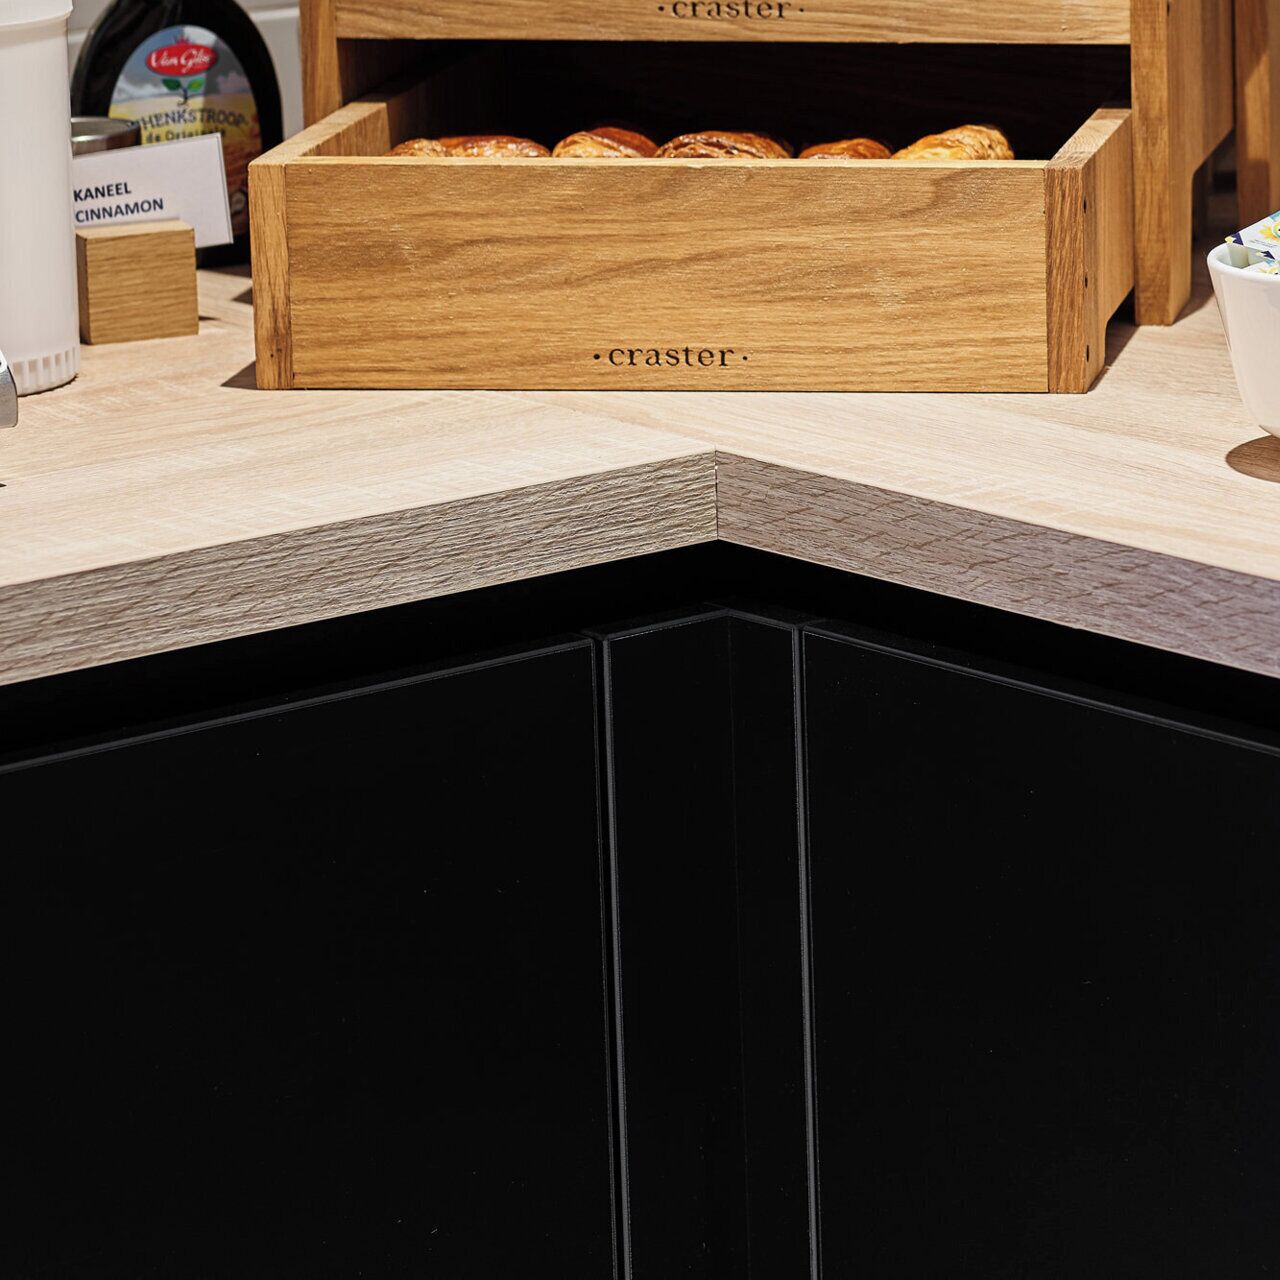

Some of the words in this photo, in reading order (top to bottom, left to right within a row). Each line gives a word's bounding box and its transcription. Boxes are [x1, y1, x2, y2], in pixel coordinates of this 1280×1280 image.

[73, 182, 132, 202] KANEEL
[75, 198, 164, 223] CINNAMON
[608, 345, 735, 367] craster
